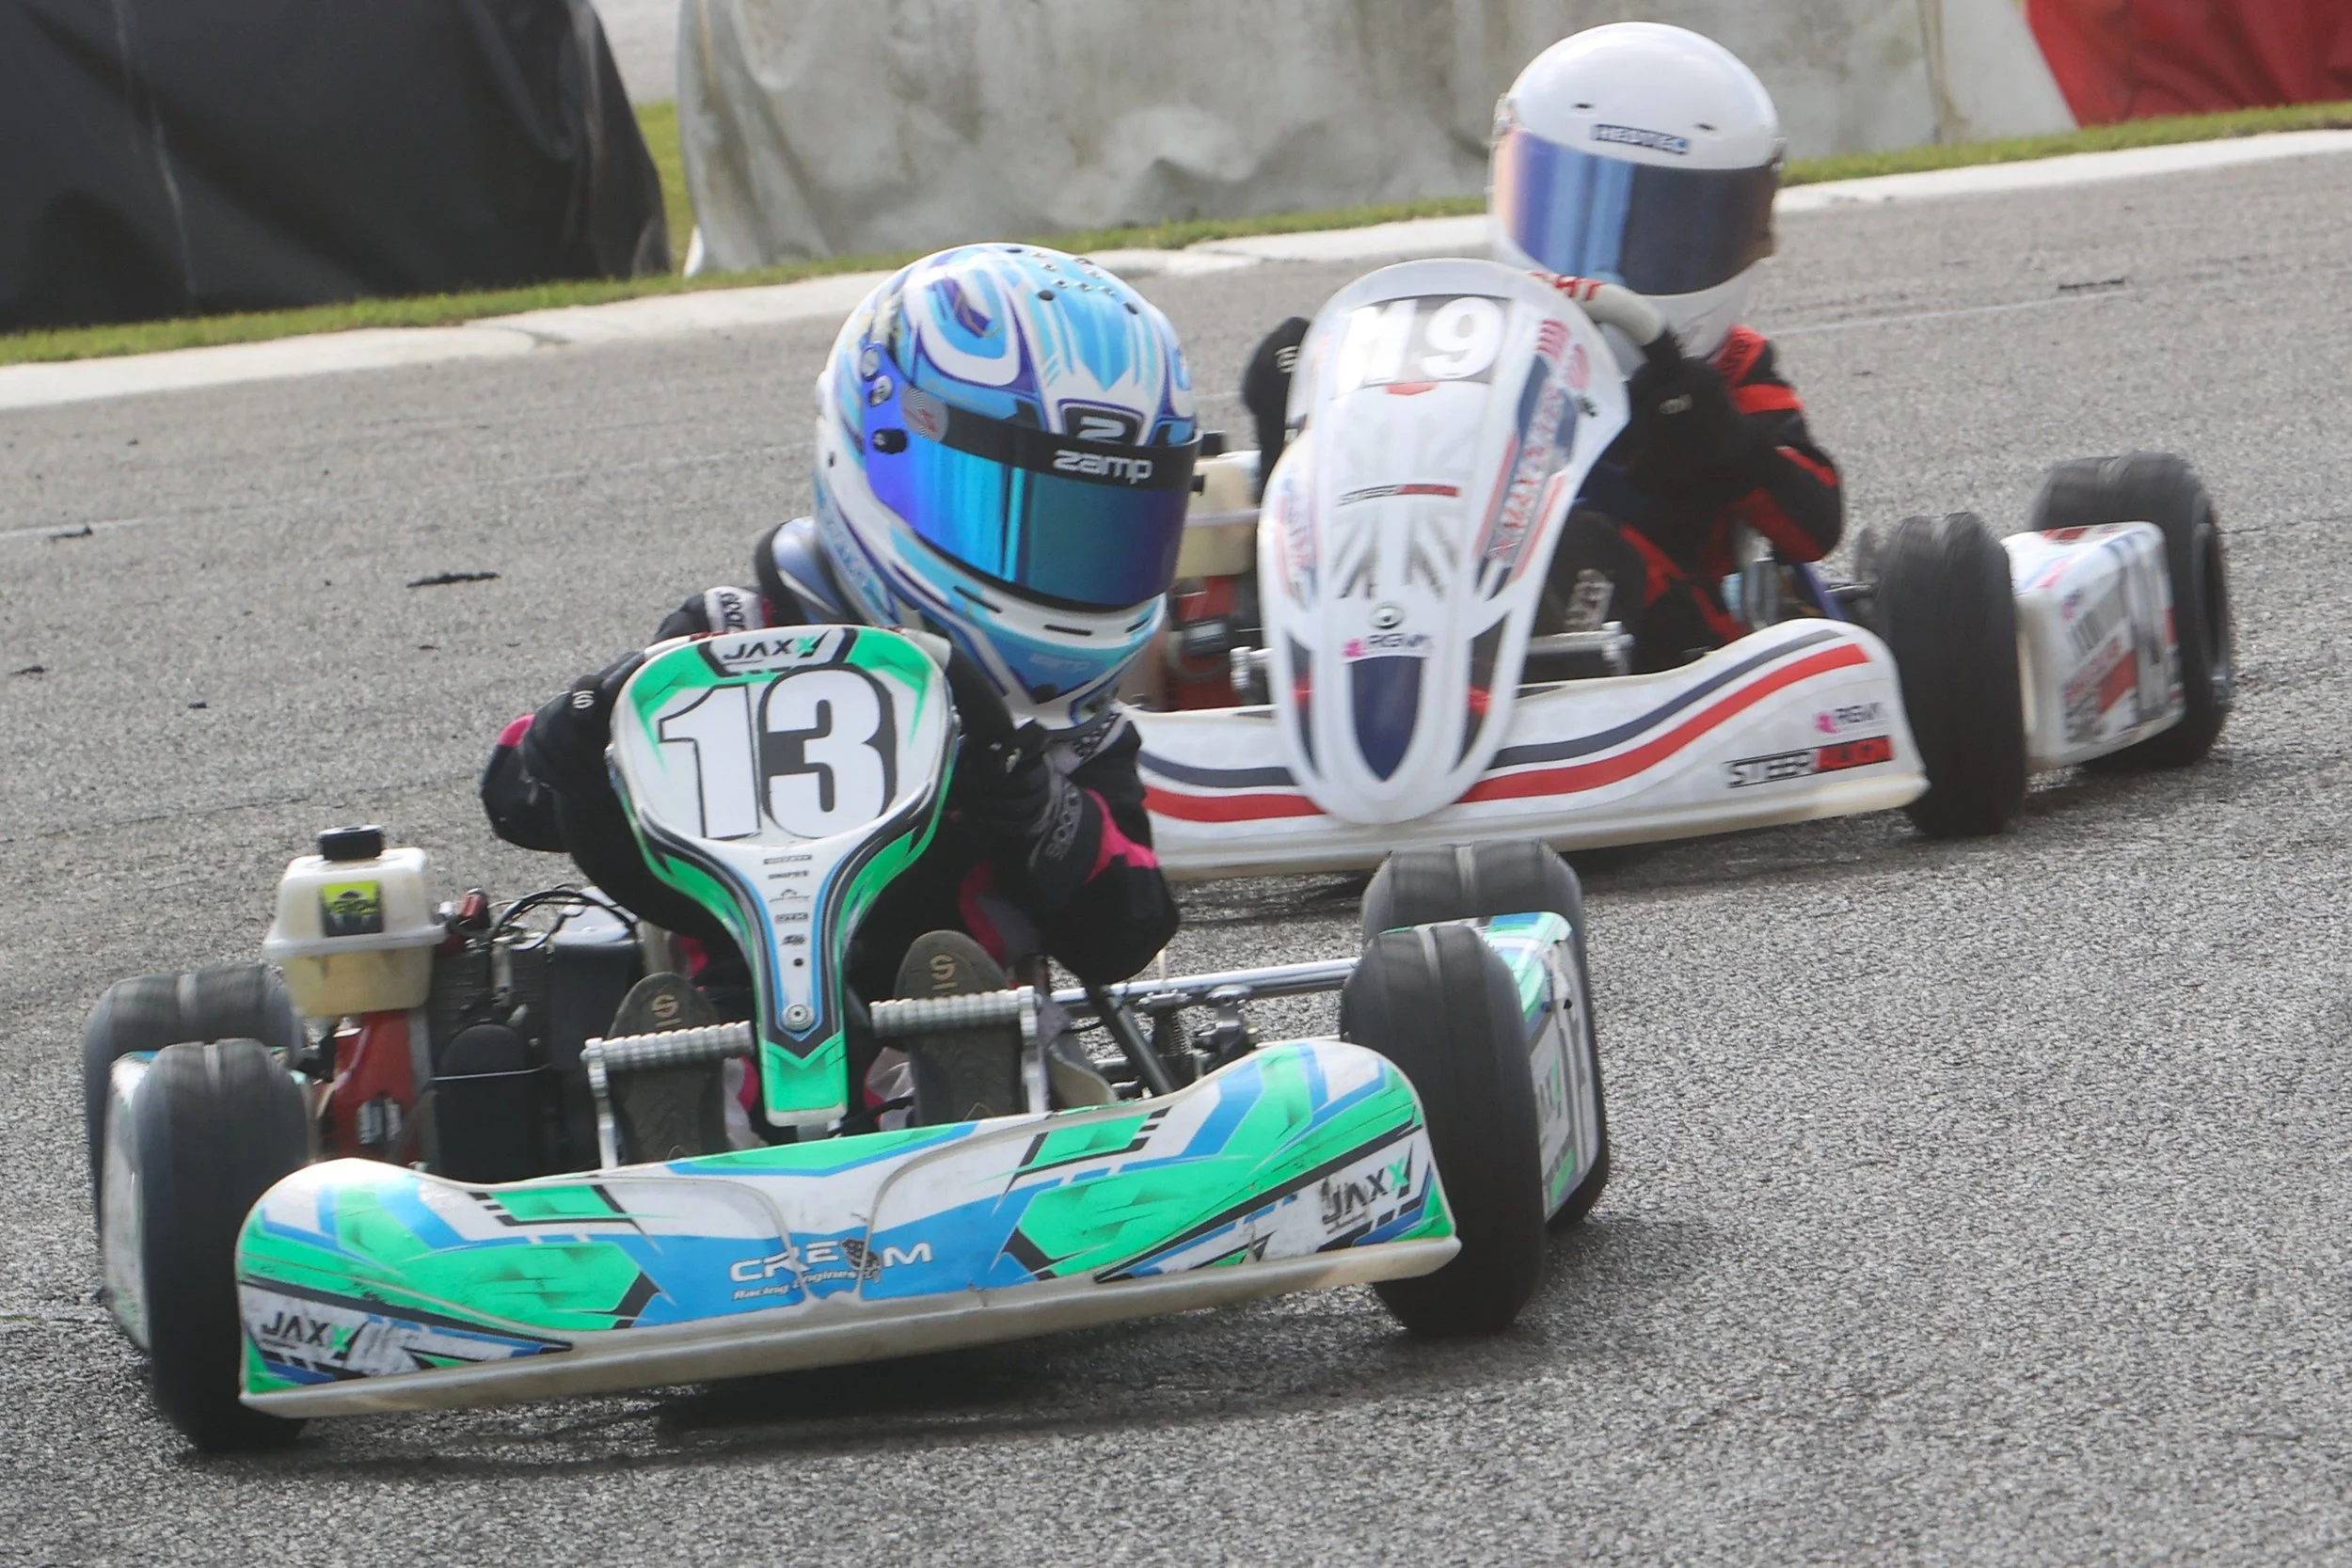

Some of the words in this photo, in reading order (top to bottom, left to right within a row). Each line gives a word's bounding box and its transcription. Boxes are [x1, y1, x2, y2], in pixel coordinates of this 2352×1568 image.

[1053, 449, 1153, 485] zamp
[659, 666, 894, 840] 13
[729, 1240, 933, 1282] CREM
